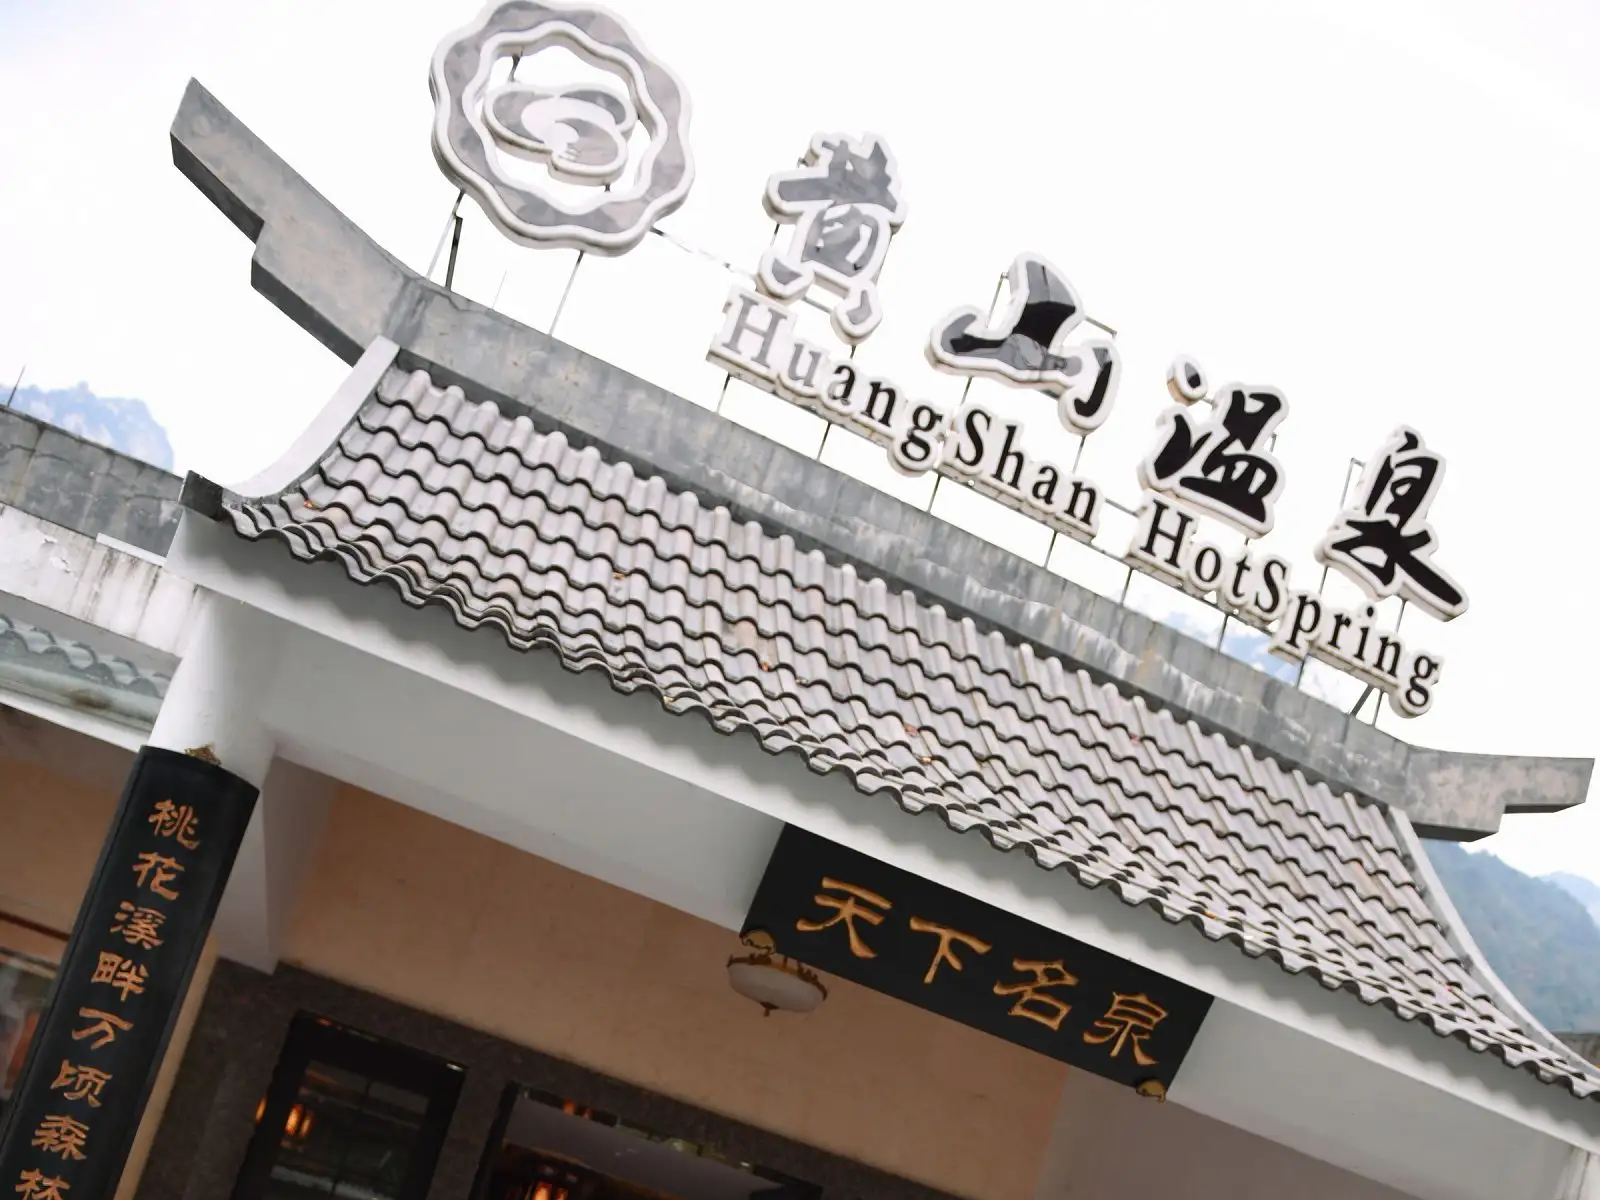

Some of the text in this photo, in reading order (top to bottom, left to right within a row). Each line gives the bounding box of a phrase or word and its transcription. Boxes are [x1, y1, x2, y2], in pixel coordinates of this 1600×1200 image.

[719, 290, 1442, 710] HuangShan HotSpring
[796, 876, 1170, 1066] 天下名泉
